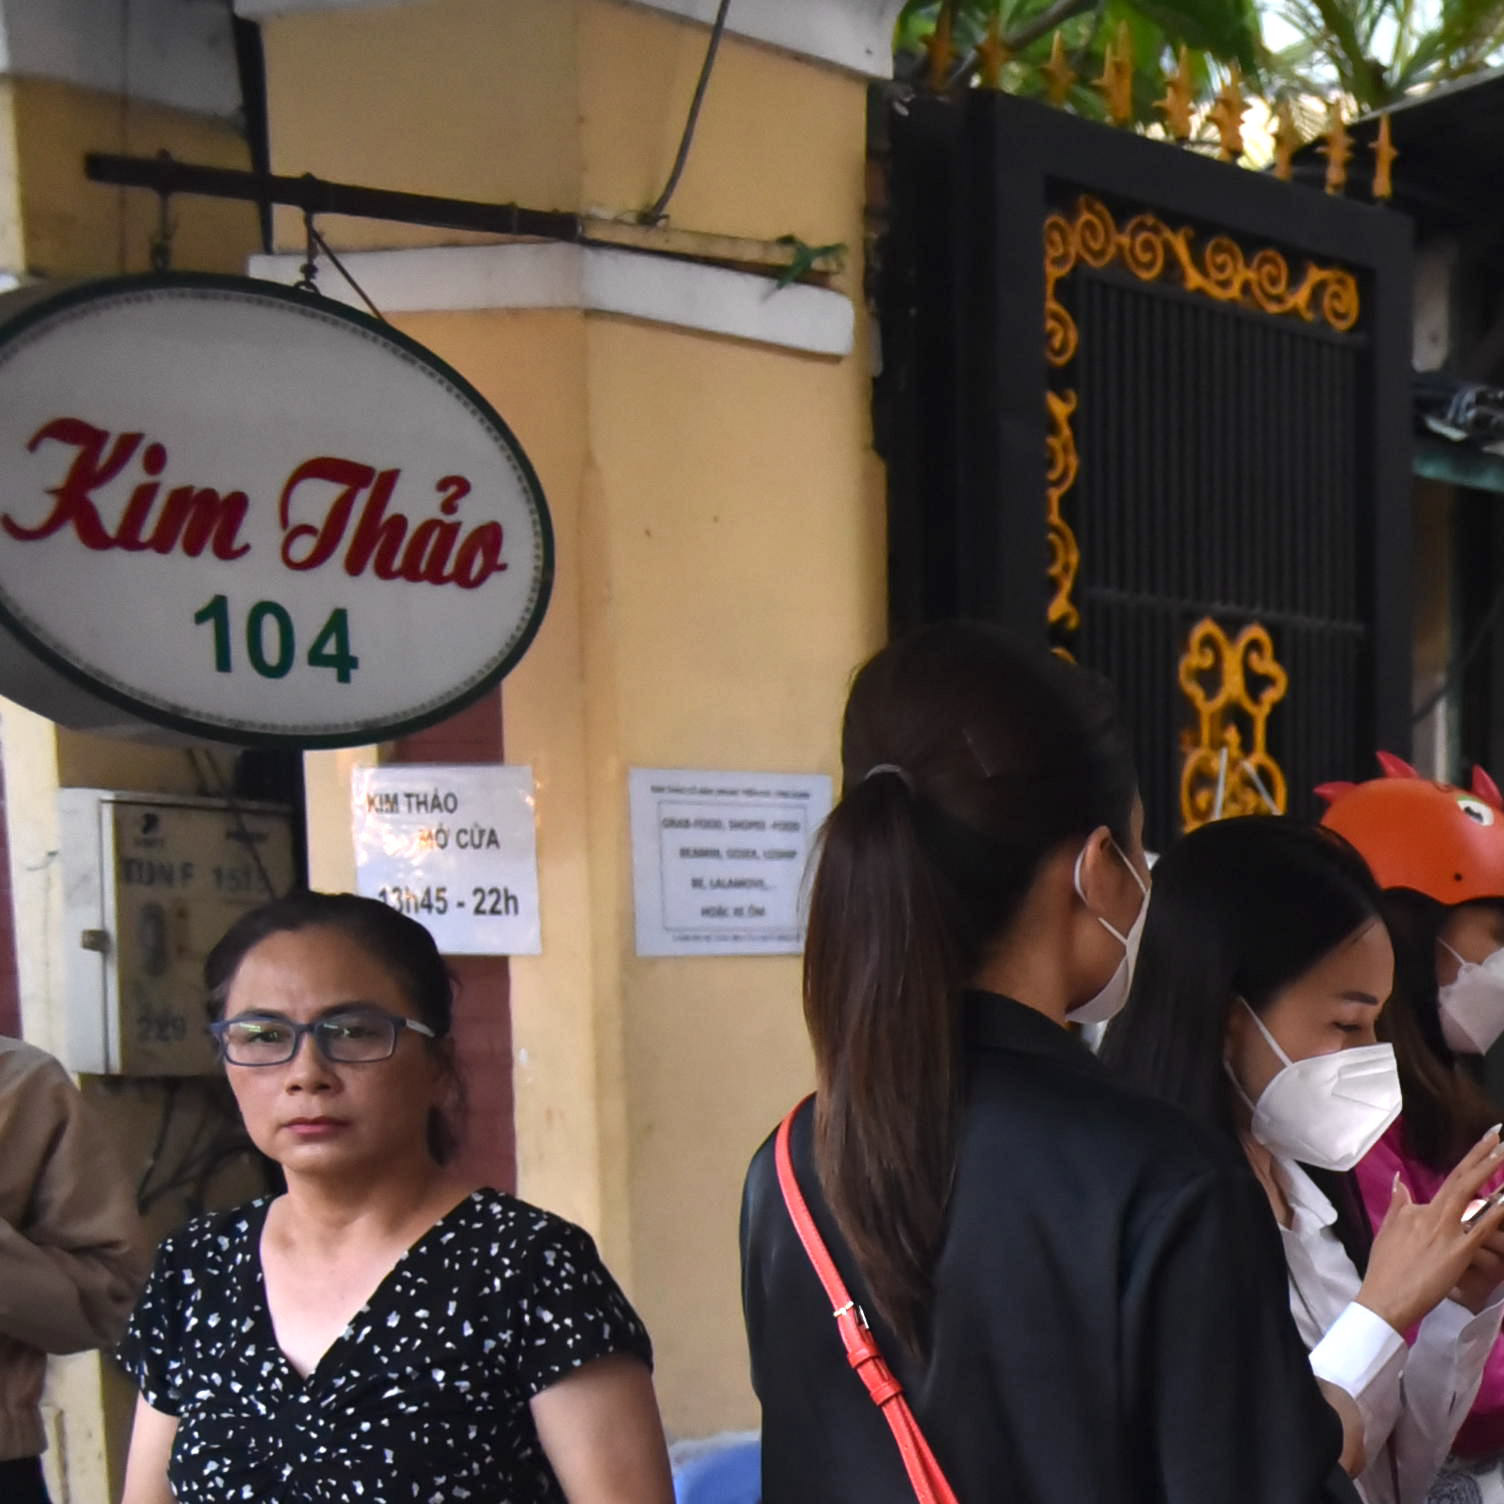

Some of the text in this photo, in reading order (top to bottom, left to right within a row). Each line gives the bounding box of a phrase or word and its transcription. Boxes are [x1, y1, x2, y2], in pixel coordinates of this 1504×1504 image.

[1, 417, 508, 589] Kim Thảo
[194, 594, 359, 684] 104
[367, 792, 399, 814] KIM
[473, 887, 519, 916] 22h
